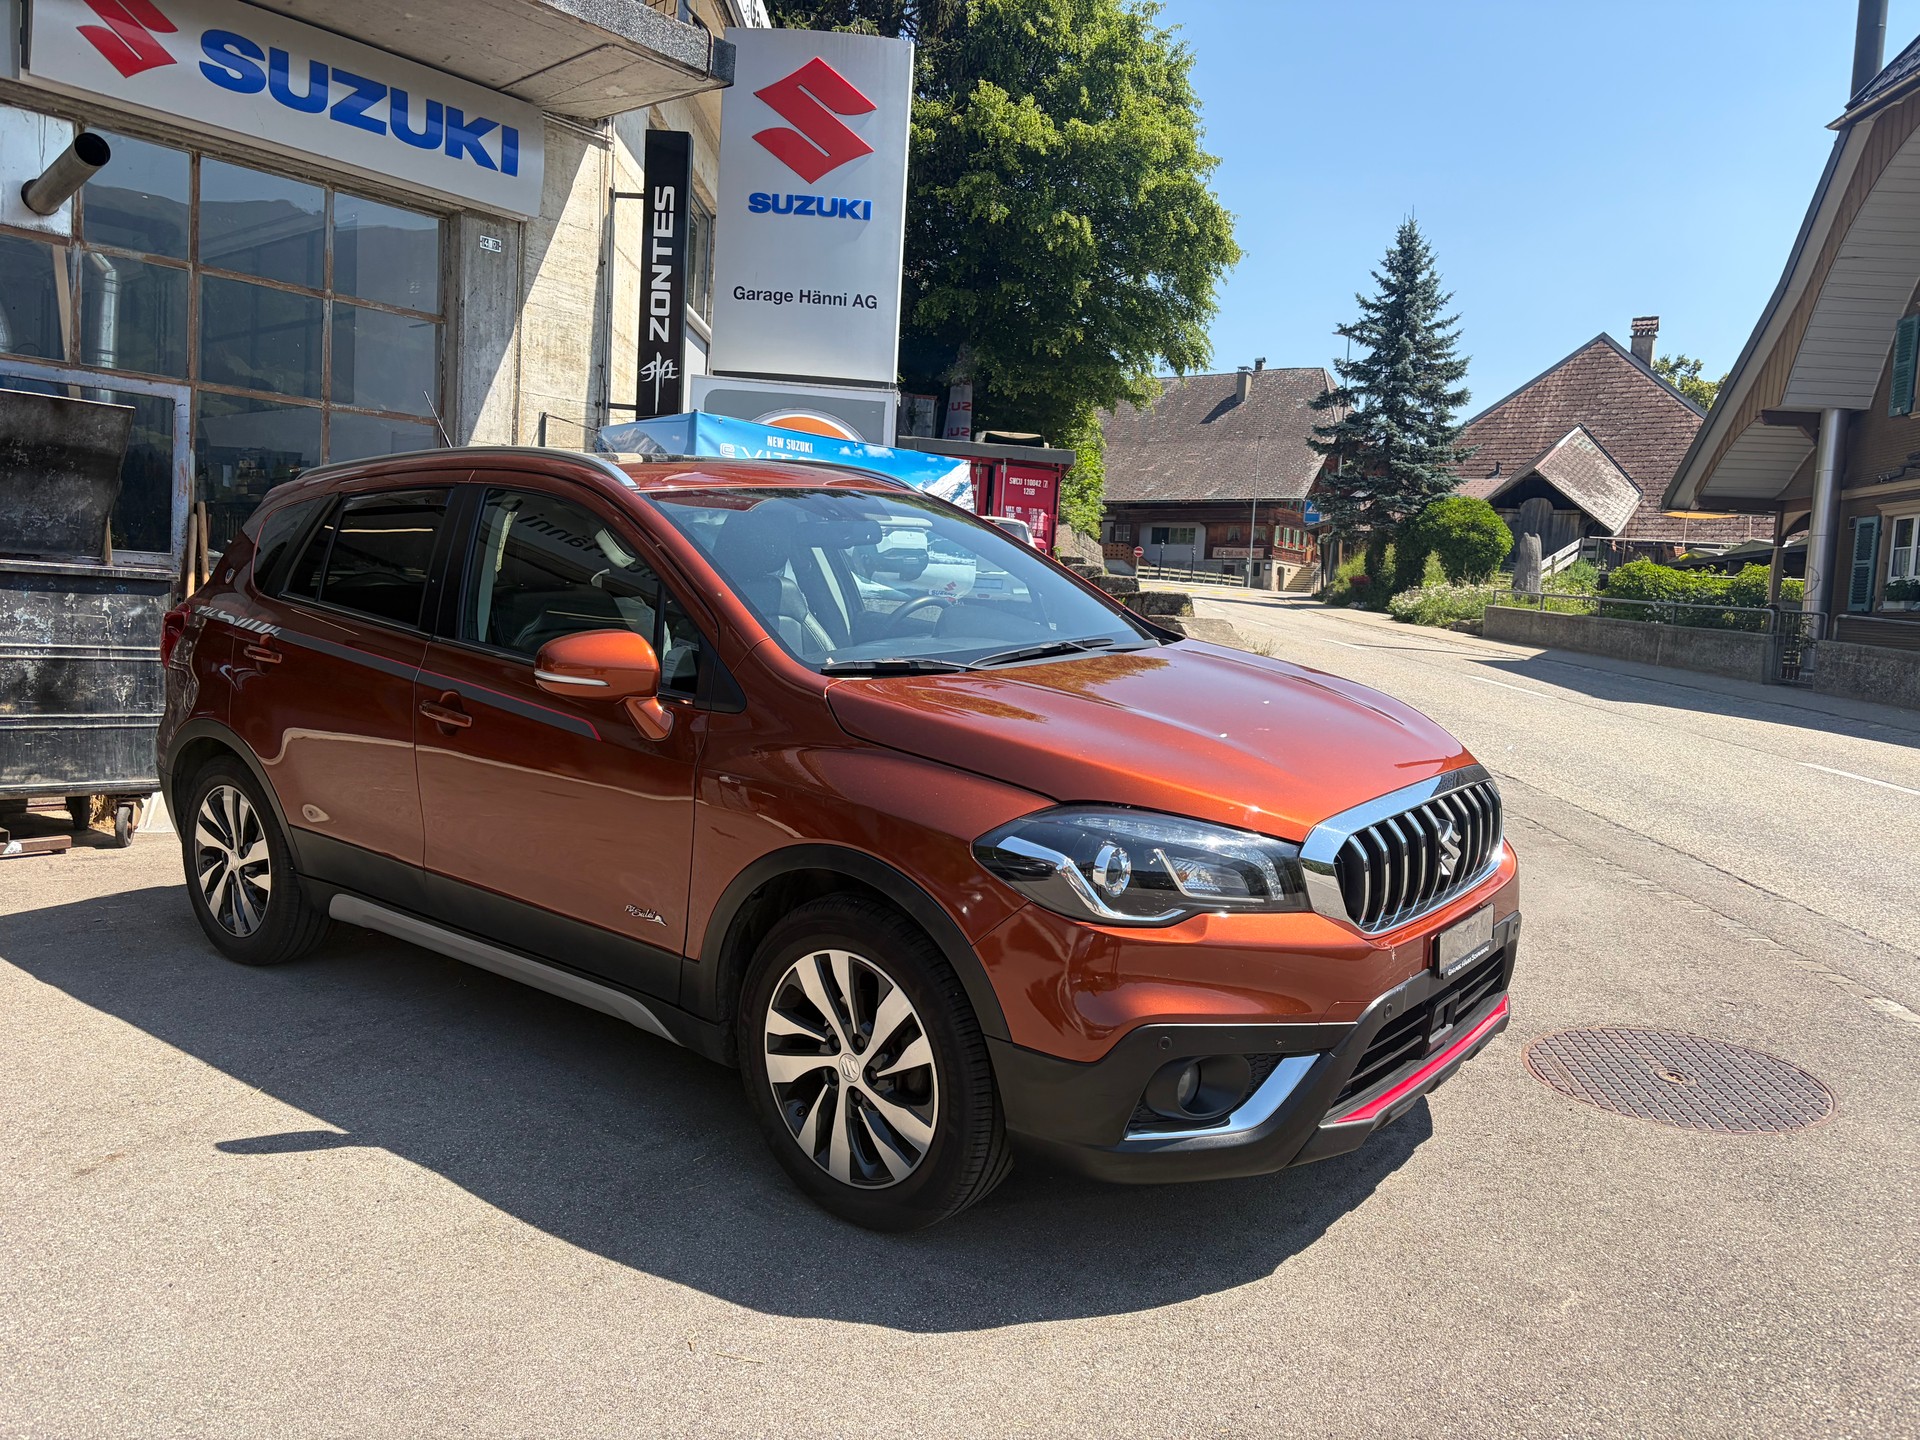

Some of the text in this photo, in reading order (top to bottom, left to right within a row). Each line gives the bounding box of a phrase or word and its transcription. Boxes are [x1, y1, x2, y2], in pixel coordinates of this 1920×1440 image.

[199, 29, 519, 177] SUZUKI
[748, 192, 872, 221] SUZUKI
[649, 186, 675, 343] ZONTES
[733, 286, 878, 309] Garage Hänni AG
[767, 435, 813, 454] NEW SUZUKI
